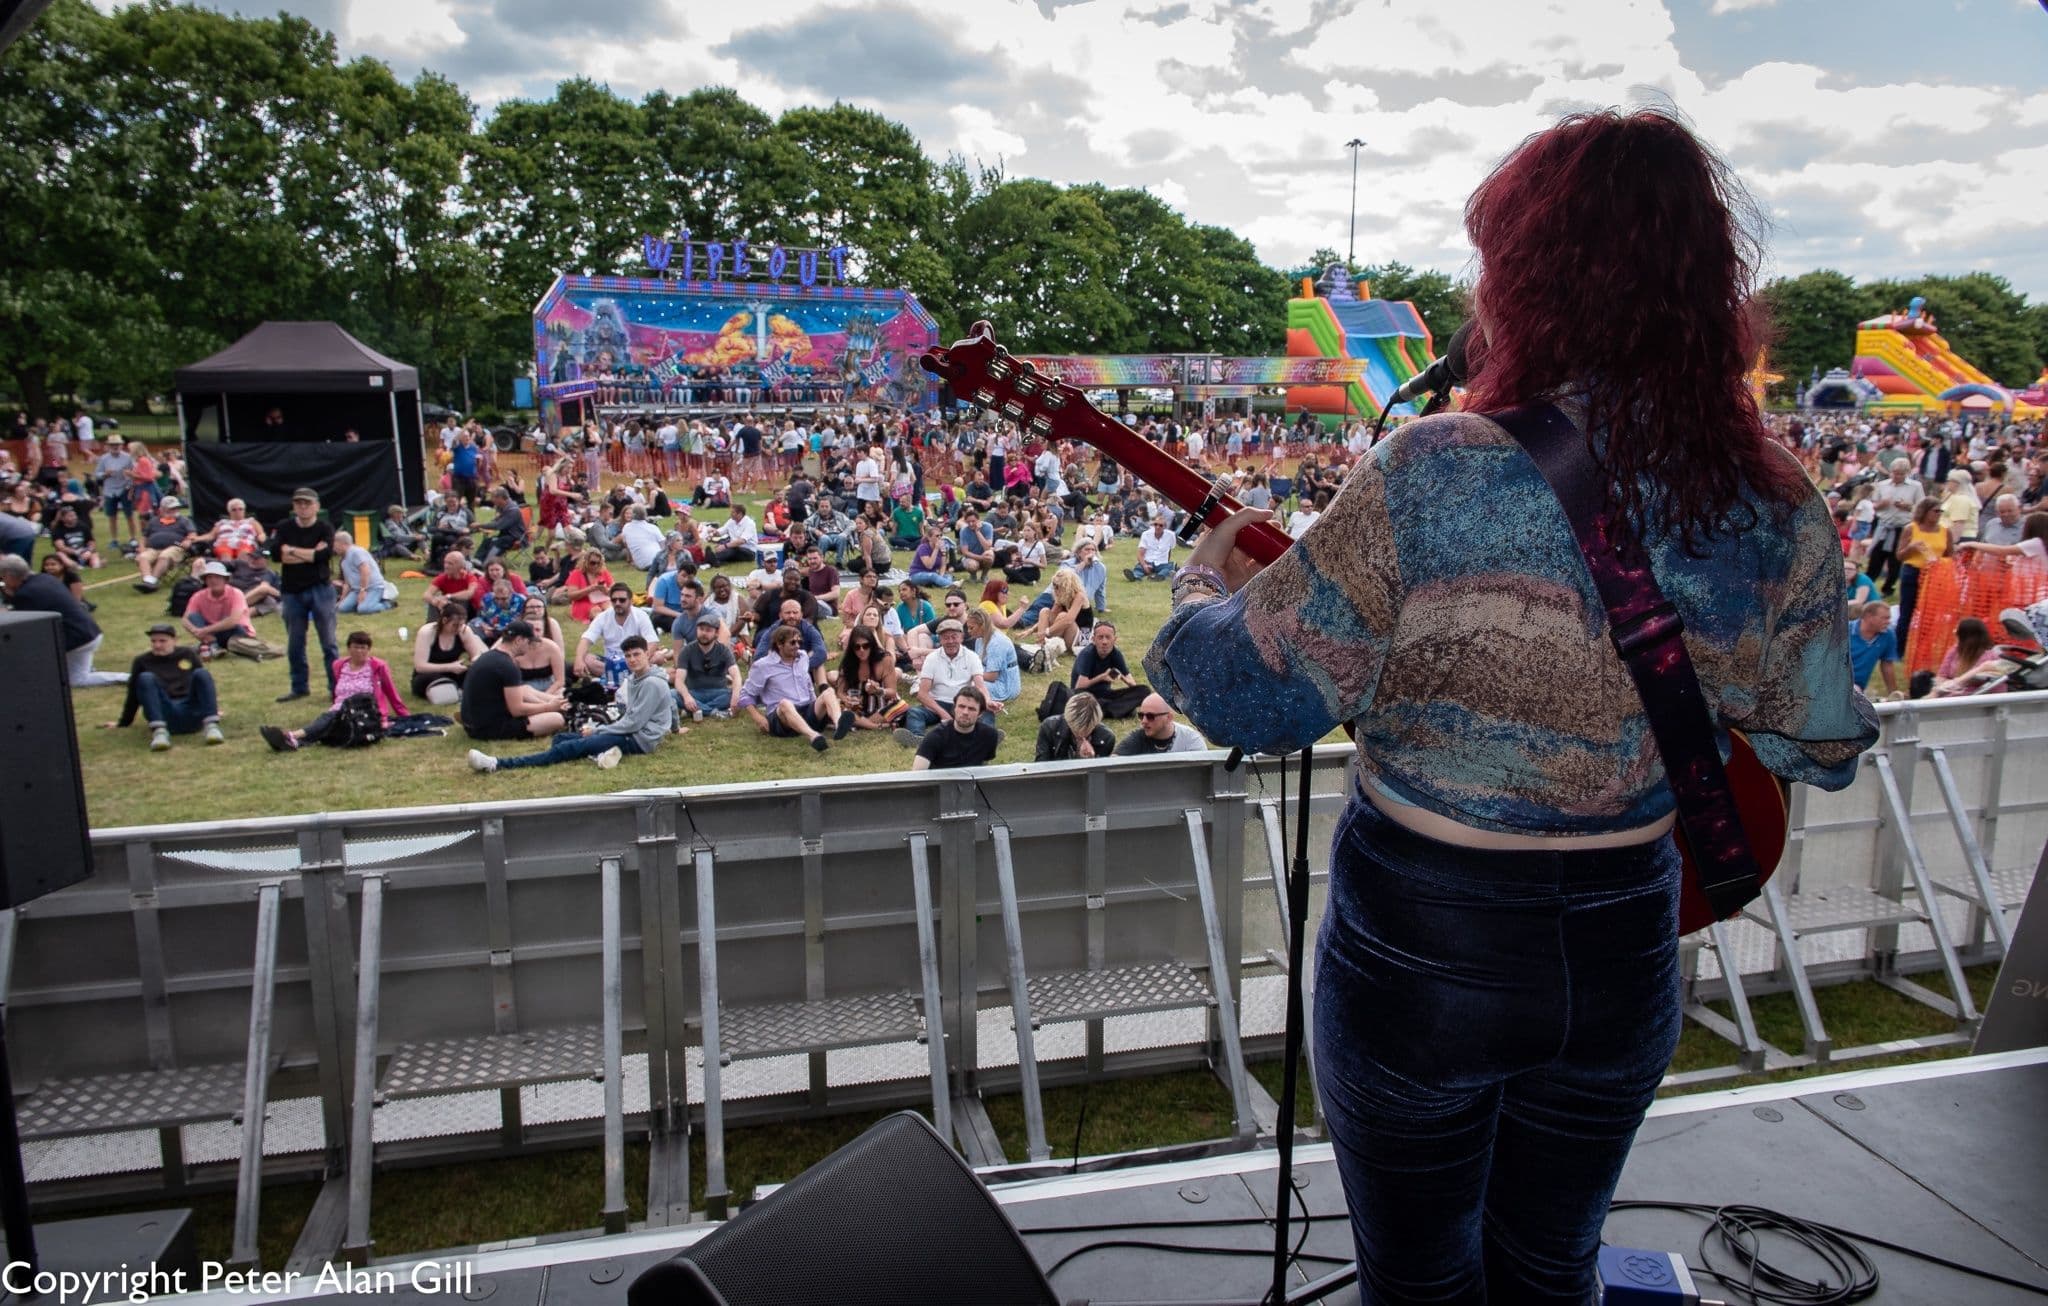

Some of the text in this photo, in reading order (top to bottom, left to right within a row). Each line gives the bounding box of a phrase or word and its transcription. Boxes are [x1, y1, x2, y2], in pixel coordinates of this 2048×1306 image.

[652, 353, 681, 376] WIPE
[660, 364, 680, 384] OUT
[761, 356, 789, 378] WIPE
[770, 365, 787, 384] OUT
[863, 356, 889, 378] WIPE
[868, 367, 886, 385] OUT
